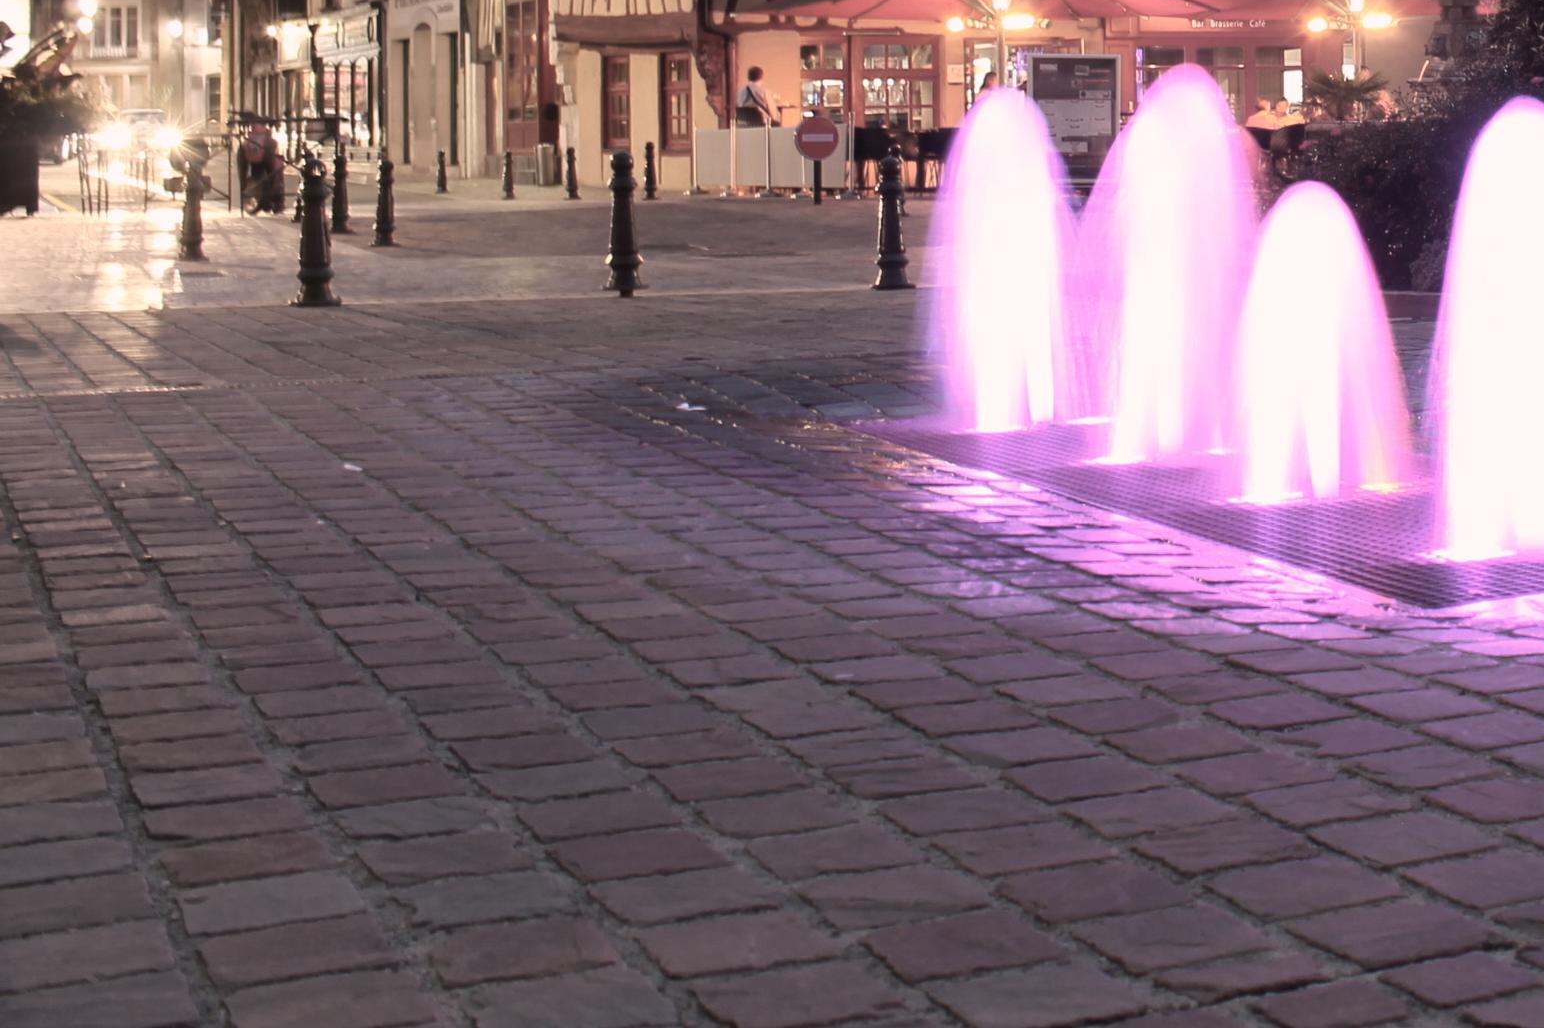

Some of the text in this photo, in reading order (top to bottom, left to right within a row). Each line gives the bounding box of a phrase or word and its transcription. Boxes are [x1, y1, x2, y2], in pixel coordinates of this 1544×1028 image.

[1191, 19, 1266, 28] Bar Brasserie Café
